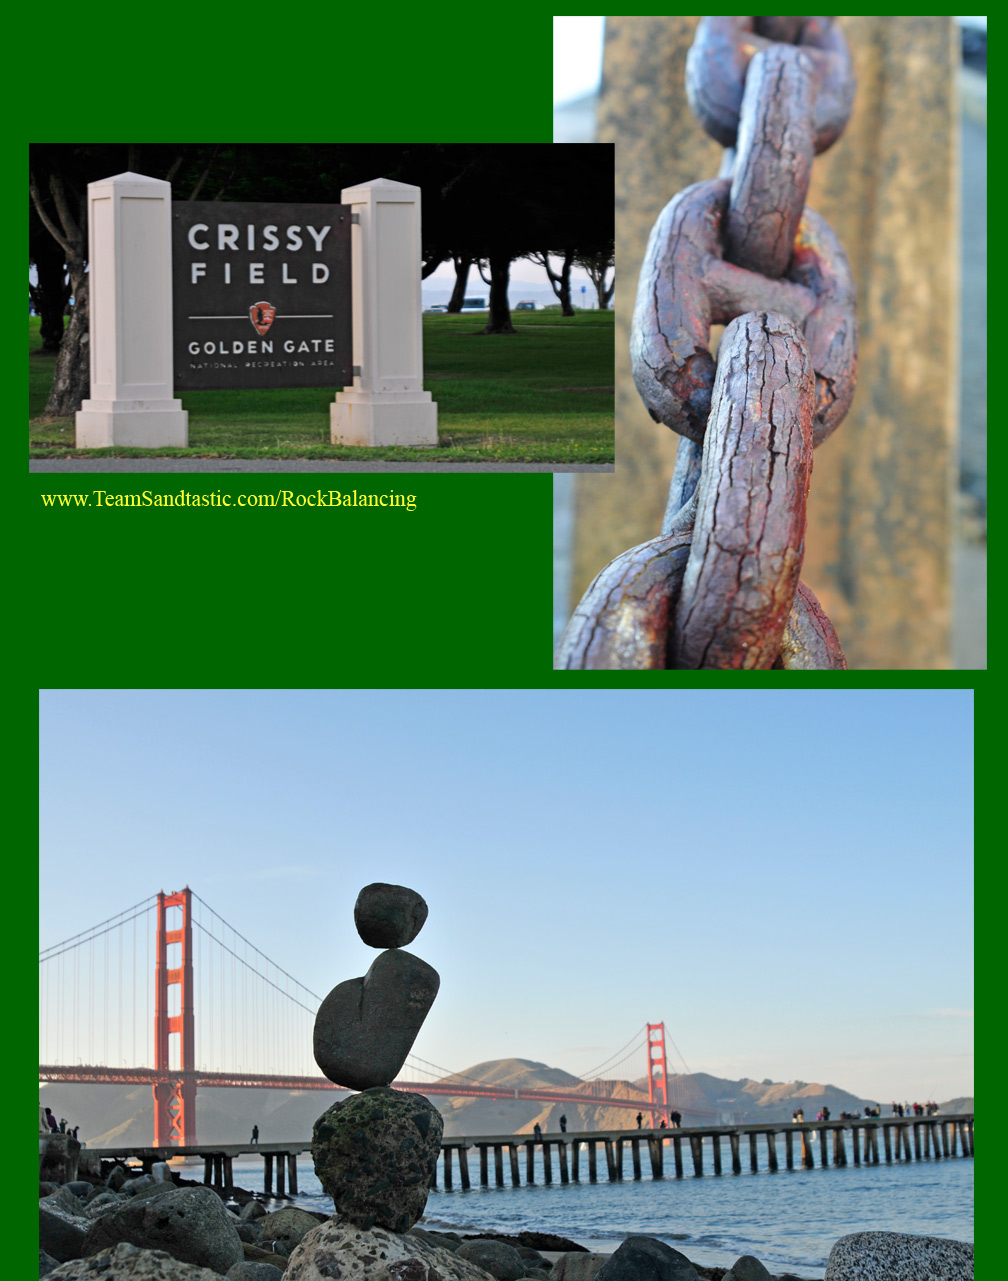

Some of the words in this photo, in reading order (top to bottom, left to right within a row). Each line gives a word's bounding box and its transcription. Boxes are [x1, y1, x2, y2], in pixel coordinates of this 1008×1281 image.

[188, 223, 331, 252] CRISSY
[191, 262, 330, 285] FIELD
[188, 340, 274, 355] GOLDEN
[284, 339, 335, 354] GATE
